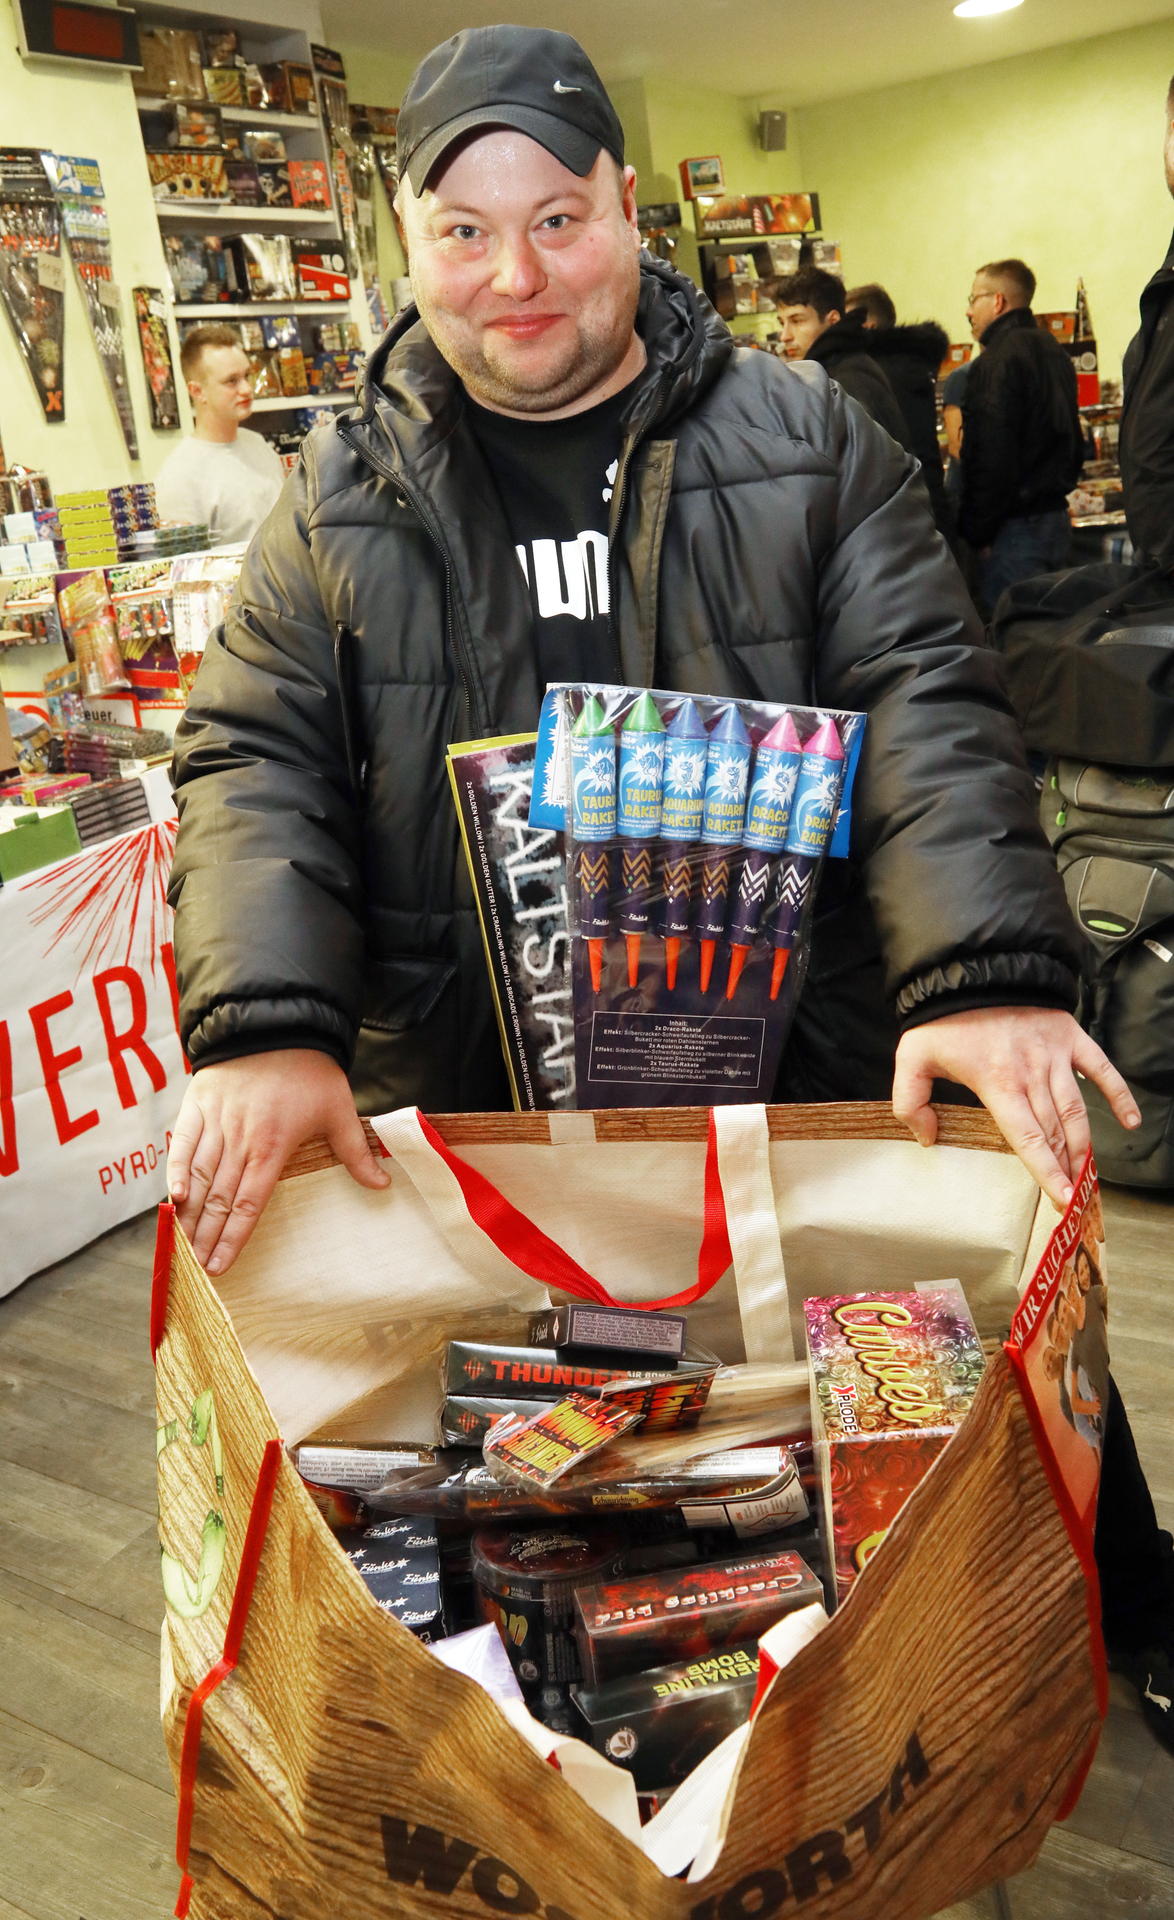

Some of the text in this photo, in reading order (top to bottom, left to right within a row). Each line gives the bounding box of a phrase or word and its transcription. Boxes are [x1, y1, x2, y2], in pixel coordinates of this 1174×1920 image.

[84, 709, 118, 723] euer,
[468, 789, 478, 815] GOLDEN
[473, 815, 483, 841] WILLOW
[804, 814, 831, 830] DRAC
[480, 852, 490, 878] GOLDEN
[486, 878, 495, 904] GLITTER
[492, 915, 504, 951] CRACKLING
[499, 951, 508, 975] WILLOW
[507, 986, 517, 1014] BROCADE
[511, 1015, 521, 1037] CROWN
[518, 1048, 528, 1073] GOLDEN
[523, 1073, 534, 1107] GLITTERING
[1079, 1155, 1099, 1208] DIC
[835, 1301, 945, 1423] Curves
[829, 1383, 859, 1433] XPLODE
[686, 1649, 751, 1677] BOMB
